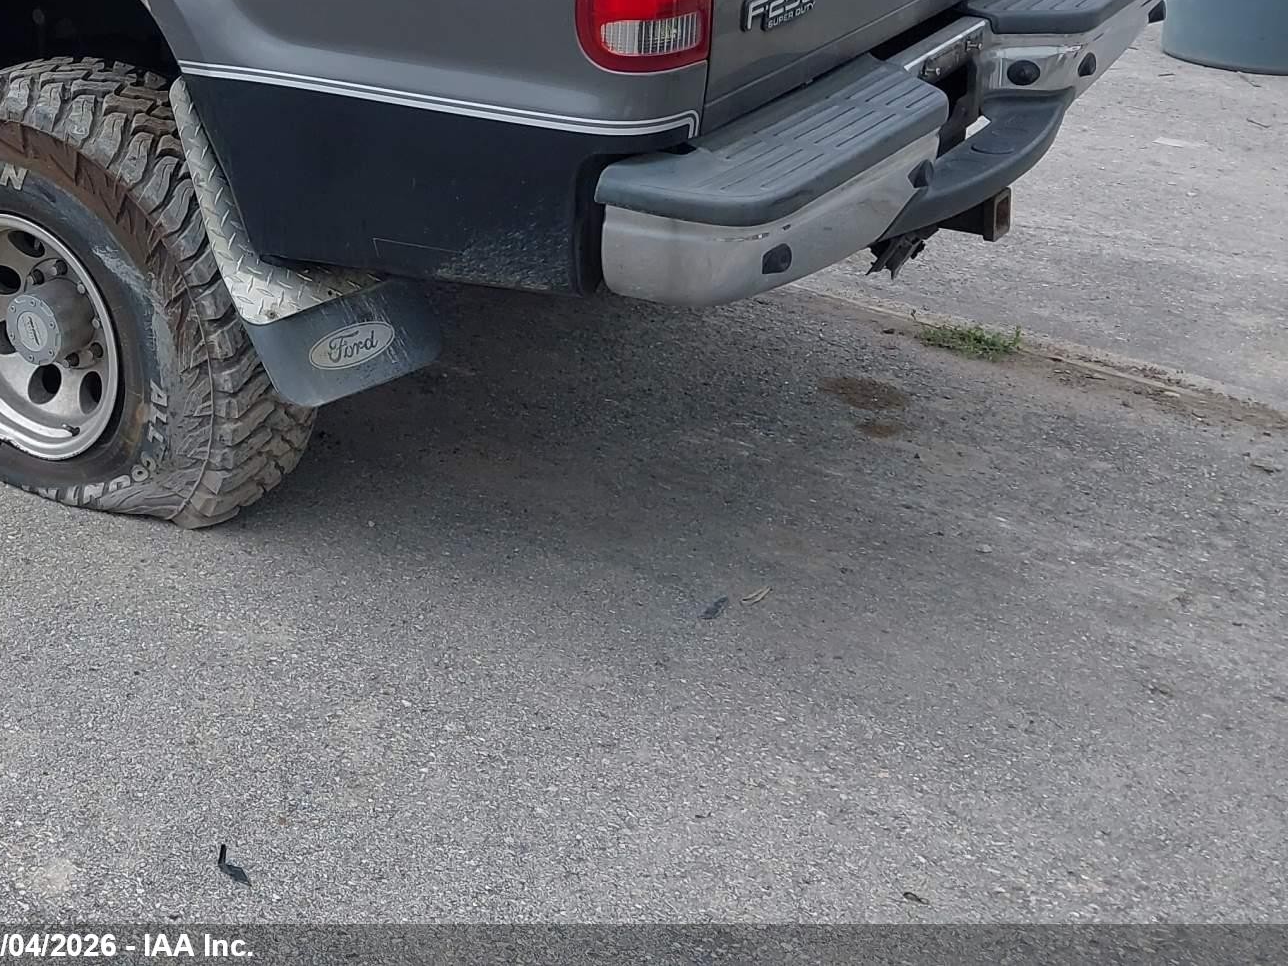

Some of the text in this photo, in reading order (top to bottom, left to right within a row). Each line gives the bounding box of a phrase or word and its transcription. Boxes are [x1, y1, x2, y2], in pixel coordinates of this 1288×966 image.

[768, 0, 817, 29] SUPER DUTY
[327, 330, 379, 364] Ford
[148, 379, 169, 443] ALL
